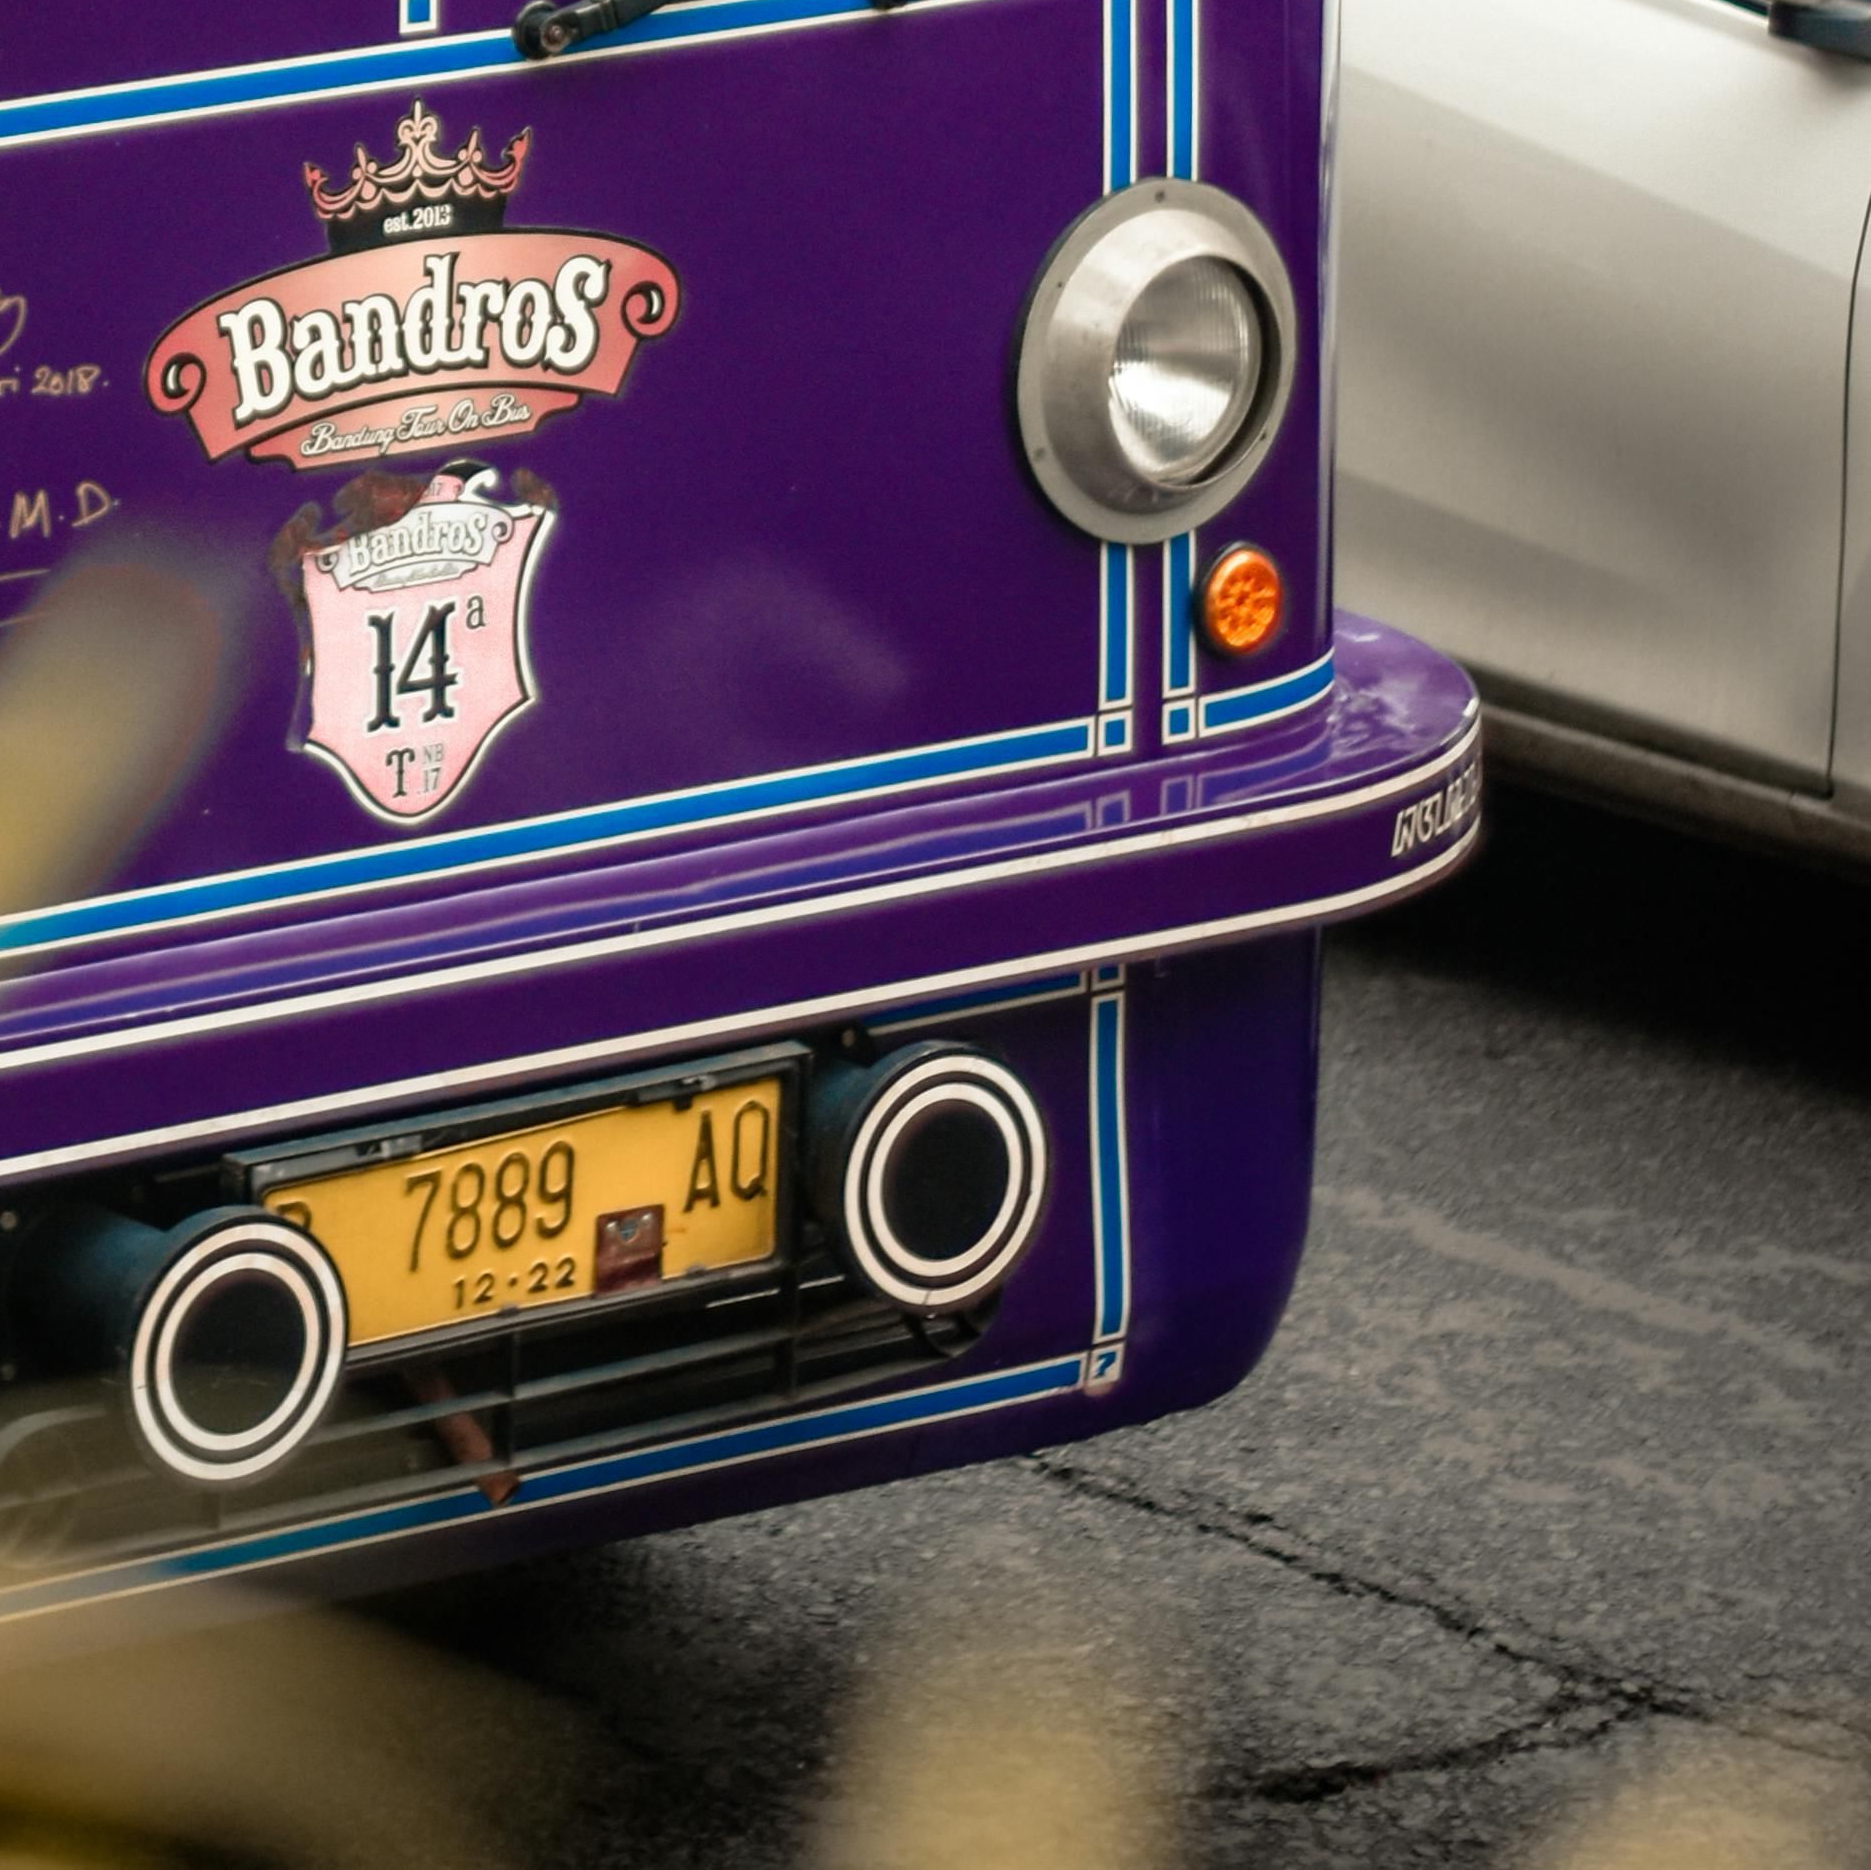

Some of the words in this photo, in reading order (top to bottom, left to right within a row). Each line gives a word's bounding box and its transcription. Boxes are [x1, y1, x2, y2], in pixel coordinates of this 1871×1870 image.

[219, 251, 610, 426] Bandros
[300, 422, 395, 455] Bandung
[396, 405, 446, 441] Tour
[448, 398, 479, 433] On
[481, 393, 532, 428] Bus
[348, 509, 489, 577] Bandros
[385, 746, 416, 799] T
[403, 1139, 577, 1274] 7889
[682, 1099, 772, 1213] AQ
